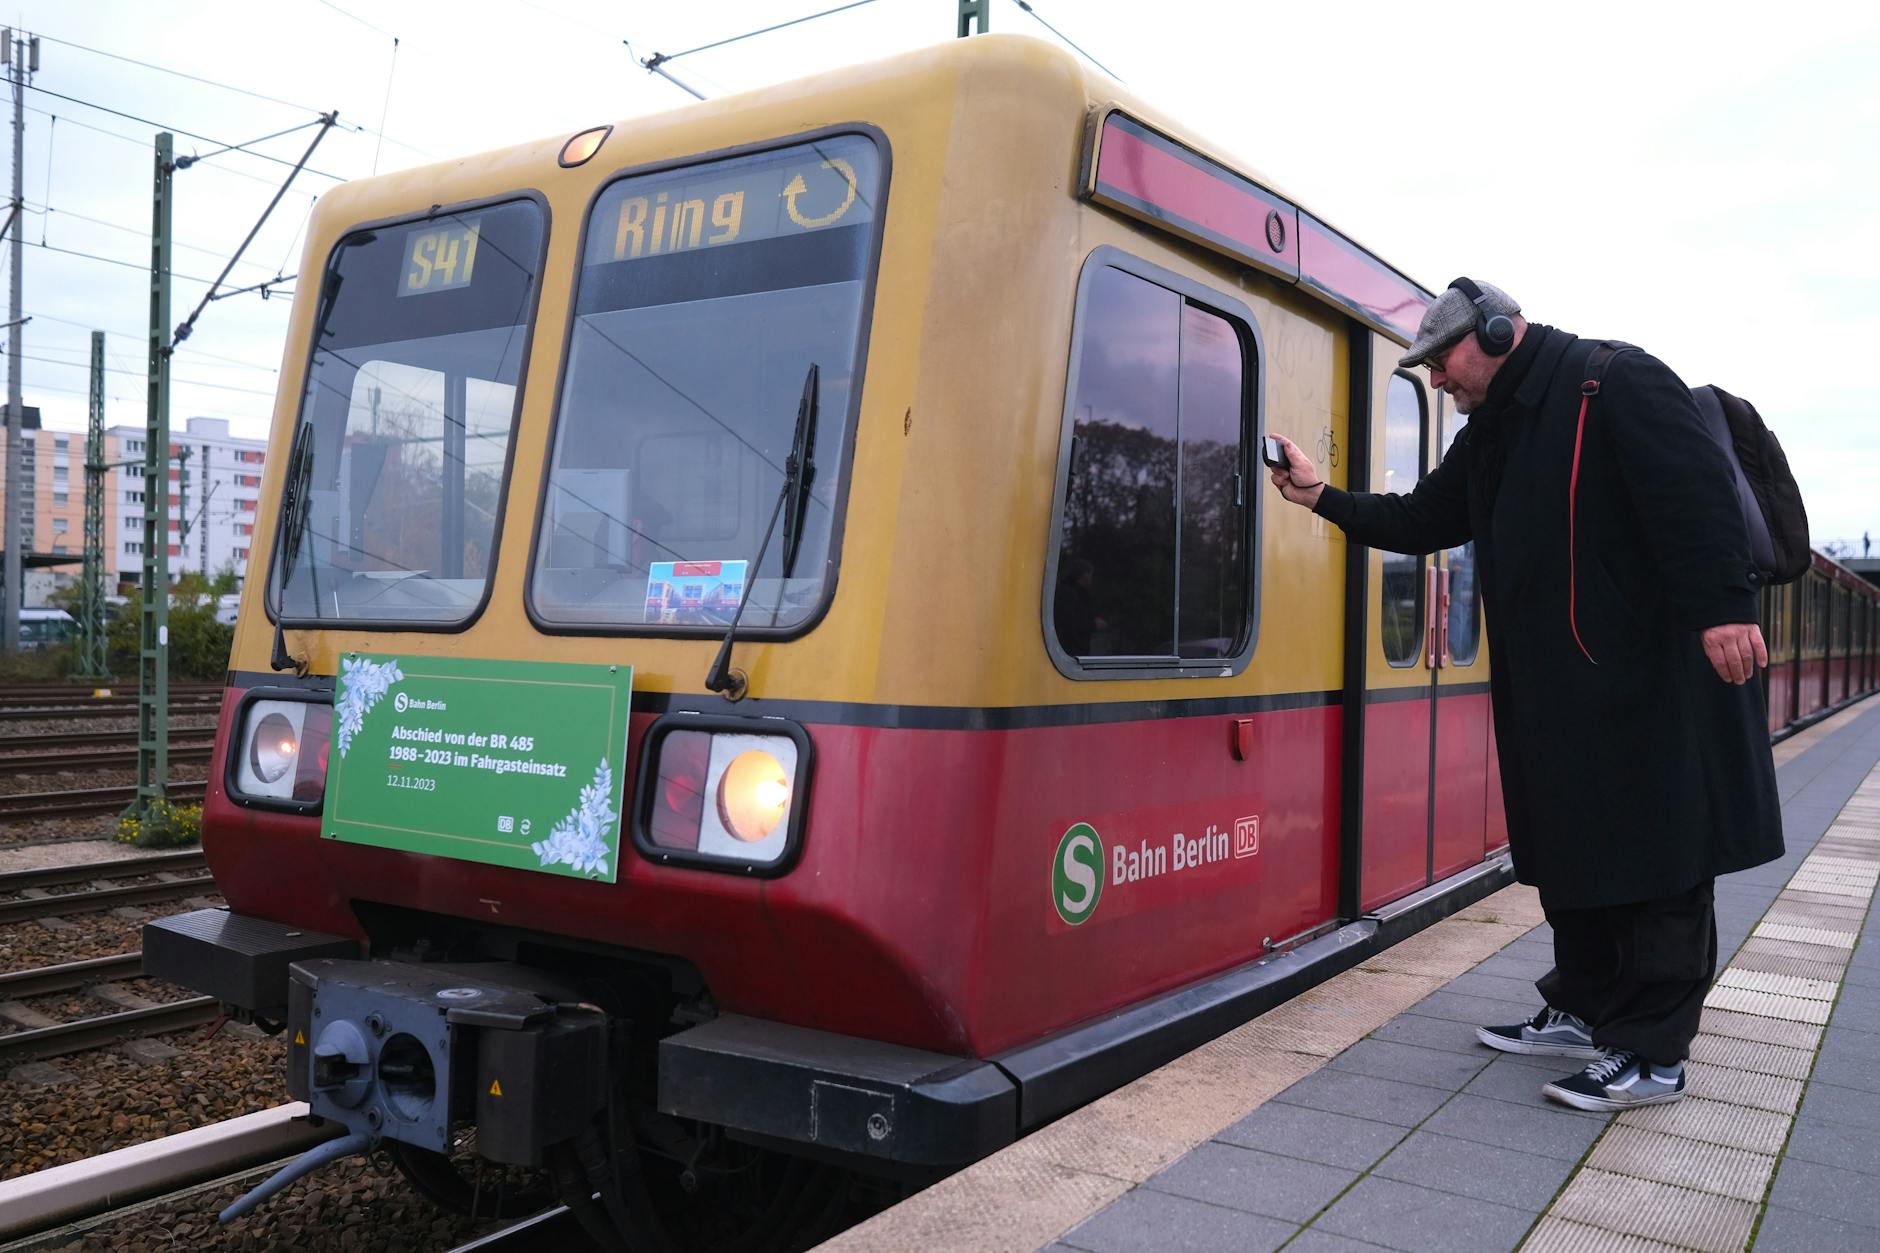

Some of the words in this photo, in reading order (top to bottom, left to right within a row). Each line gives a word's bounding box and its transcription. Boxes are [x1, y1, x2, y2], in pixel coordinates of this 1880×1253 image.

[614, 189, 745, 261] Ring
[407, 222, 481, 290] S41
[408, 699, 426, 709] Bahn
[426, 699, 447, 711] Berlin
[391, 725, 443, 743] Abschied
[444, 733, 466, 745] von
[467, 732, 488, 748] der
[490, 734, 507, 749] BR
[509, 735, 534, 752] 485
[453, 751, 469, 767] im
[470, 753, 567, 777] Fahrgasteinsatz
[387, 774, 436, 791] 12.11.2023
[1061, 833, 1098, 916] S
[1112, 838, 1167, 886] Bahn
[1173, 824, 1229, 872] Berlin
